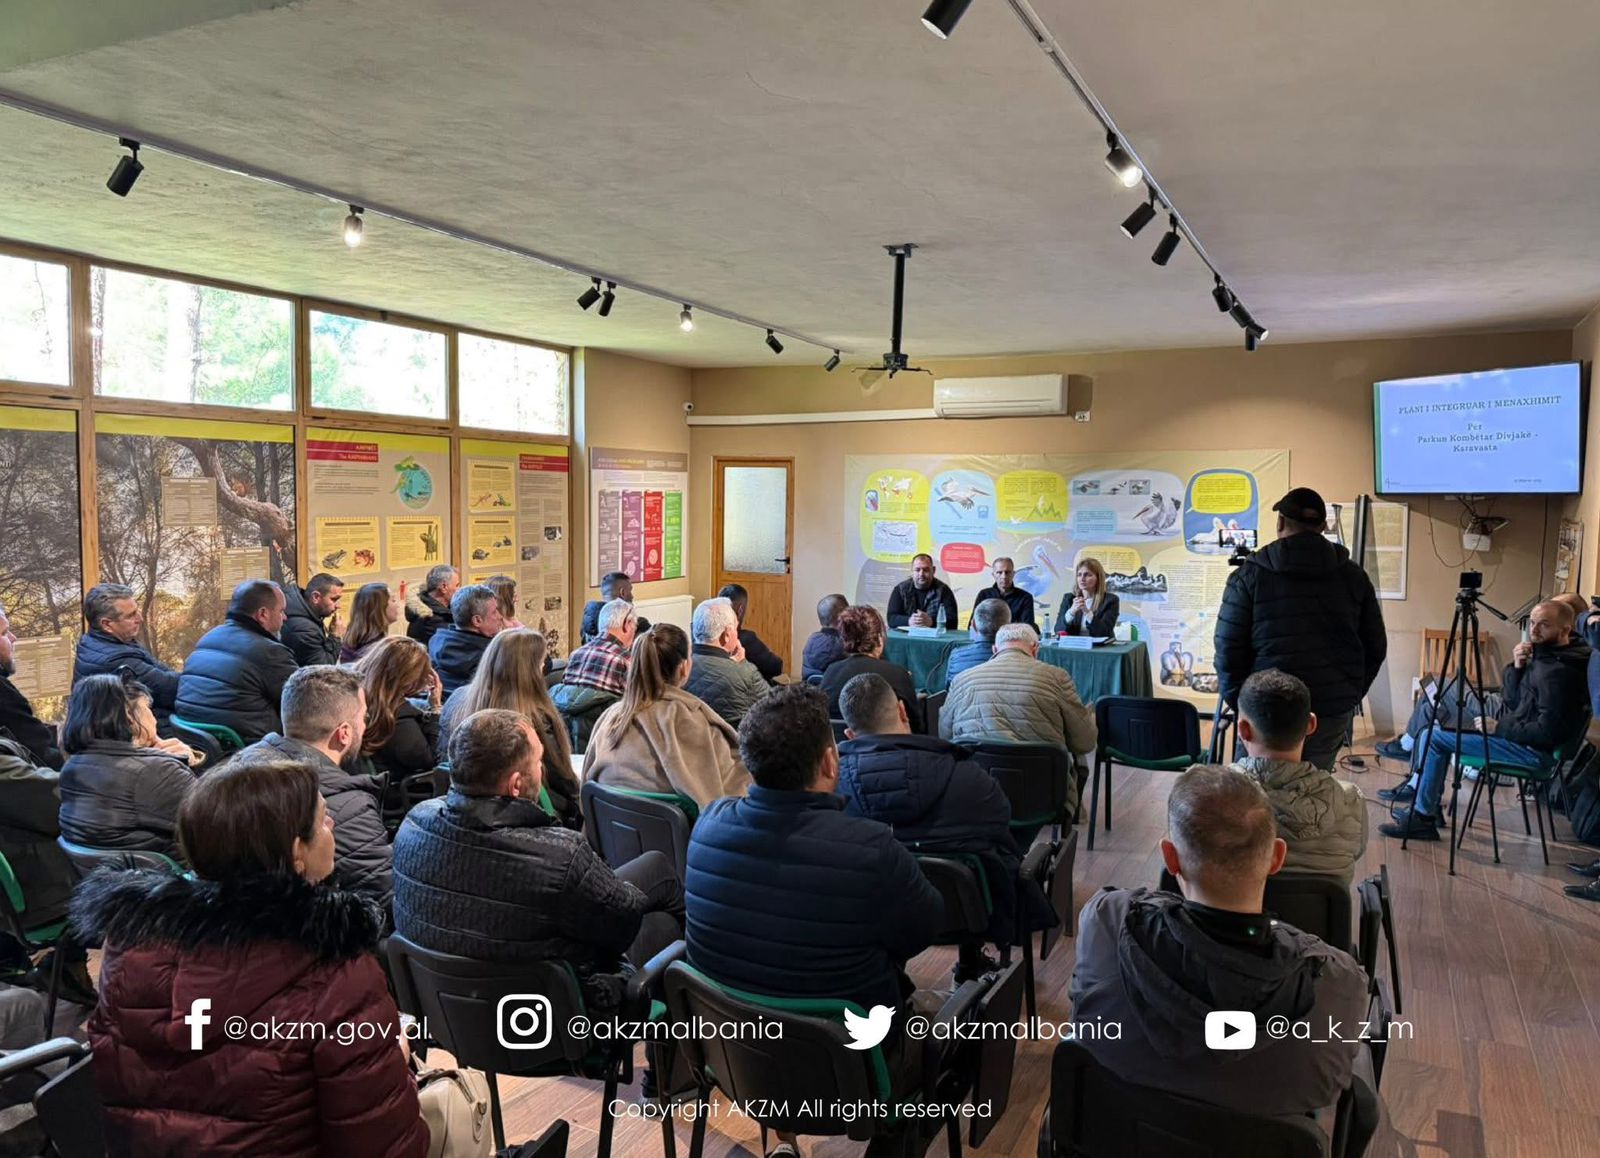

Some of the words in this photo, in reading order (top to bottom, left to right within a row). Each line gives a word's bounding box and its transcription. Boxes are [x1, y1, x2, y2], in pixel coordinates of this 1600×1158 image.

[1399, 405, 1424, 415] PLANI
[1432, 401, 1486, 412] INTEGRUAR
[1494, 395, 1562, 408] MENAXHIMIT
